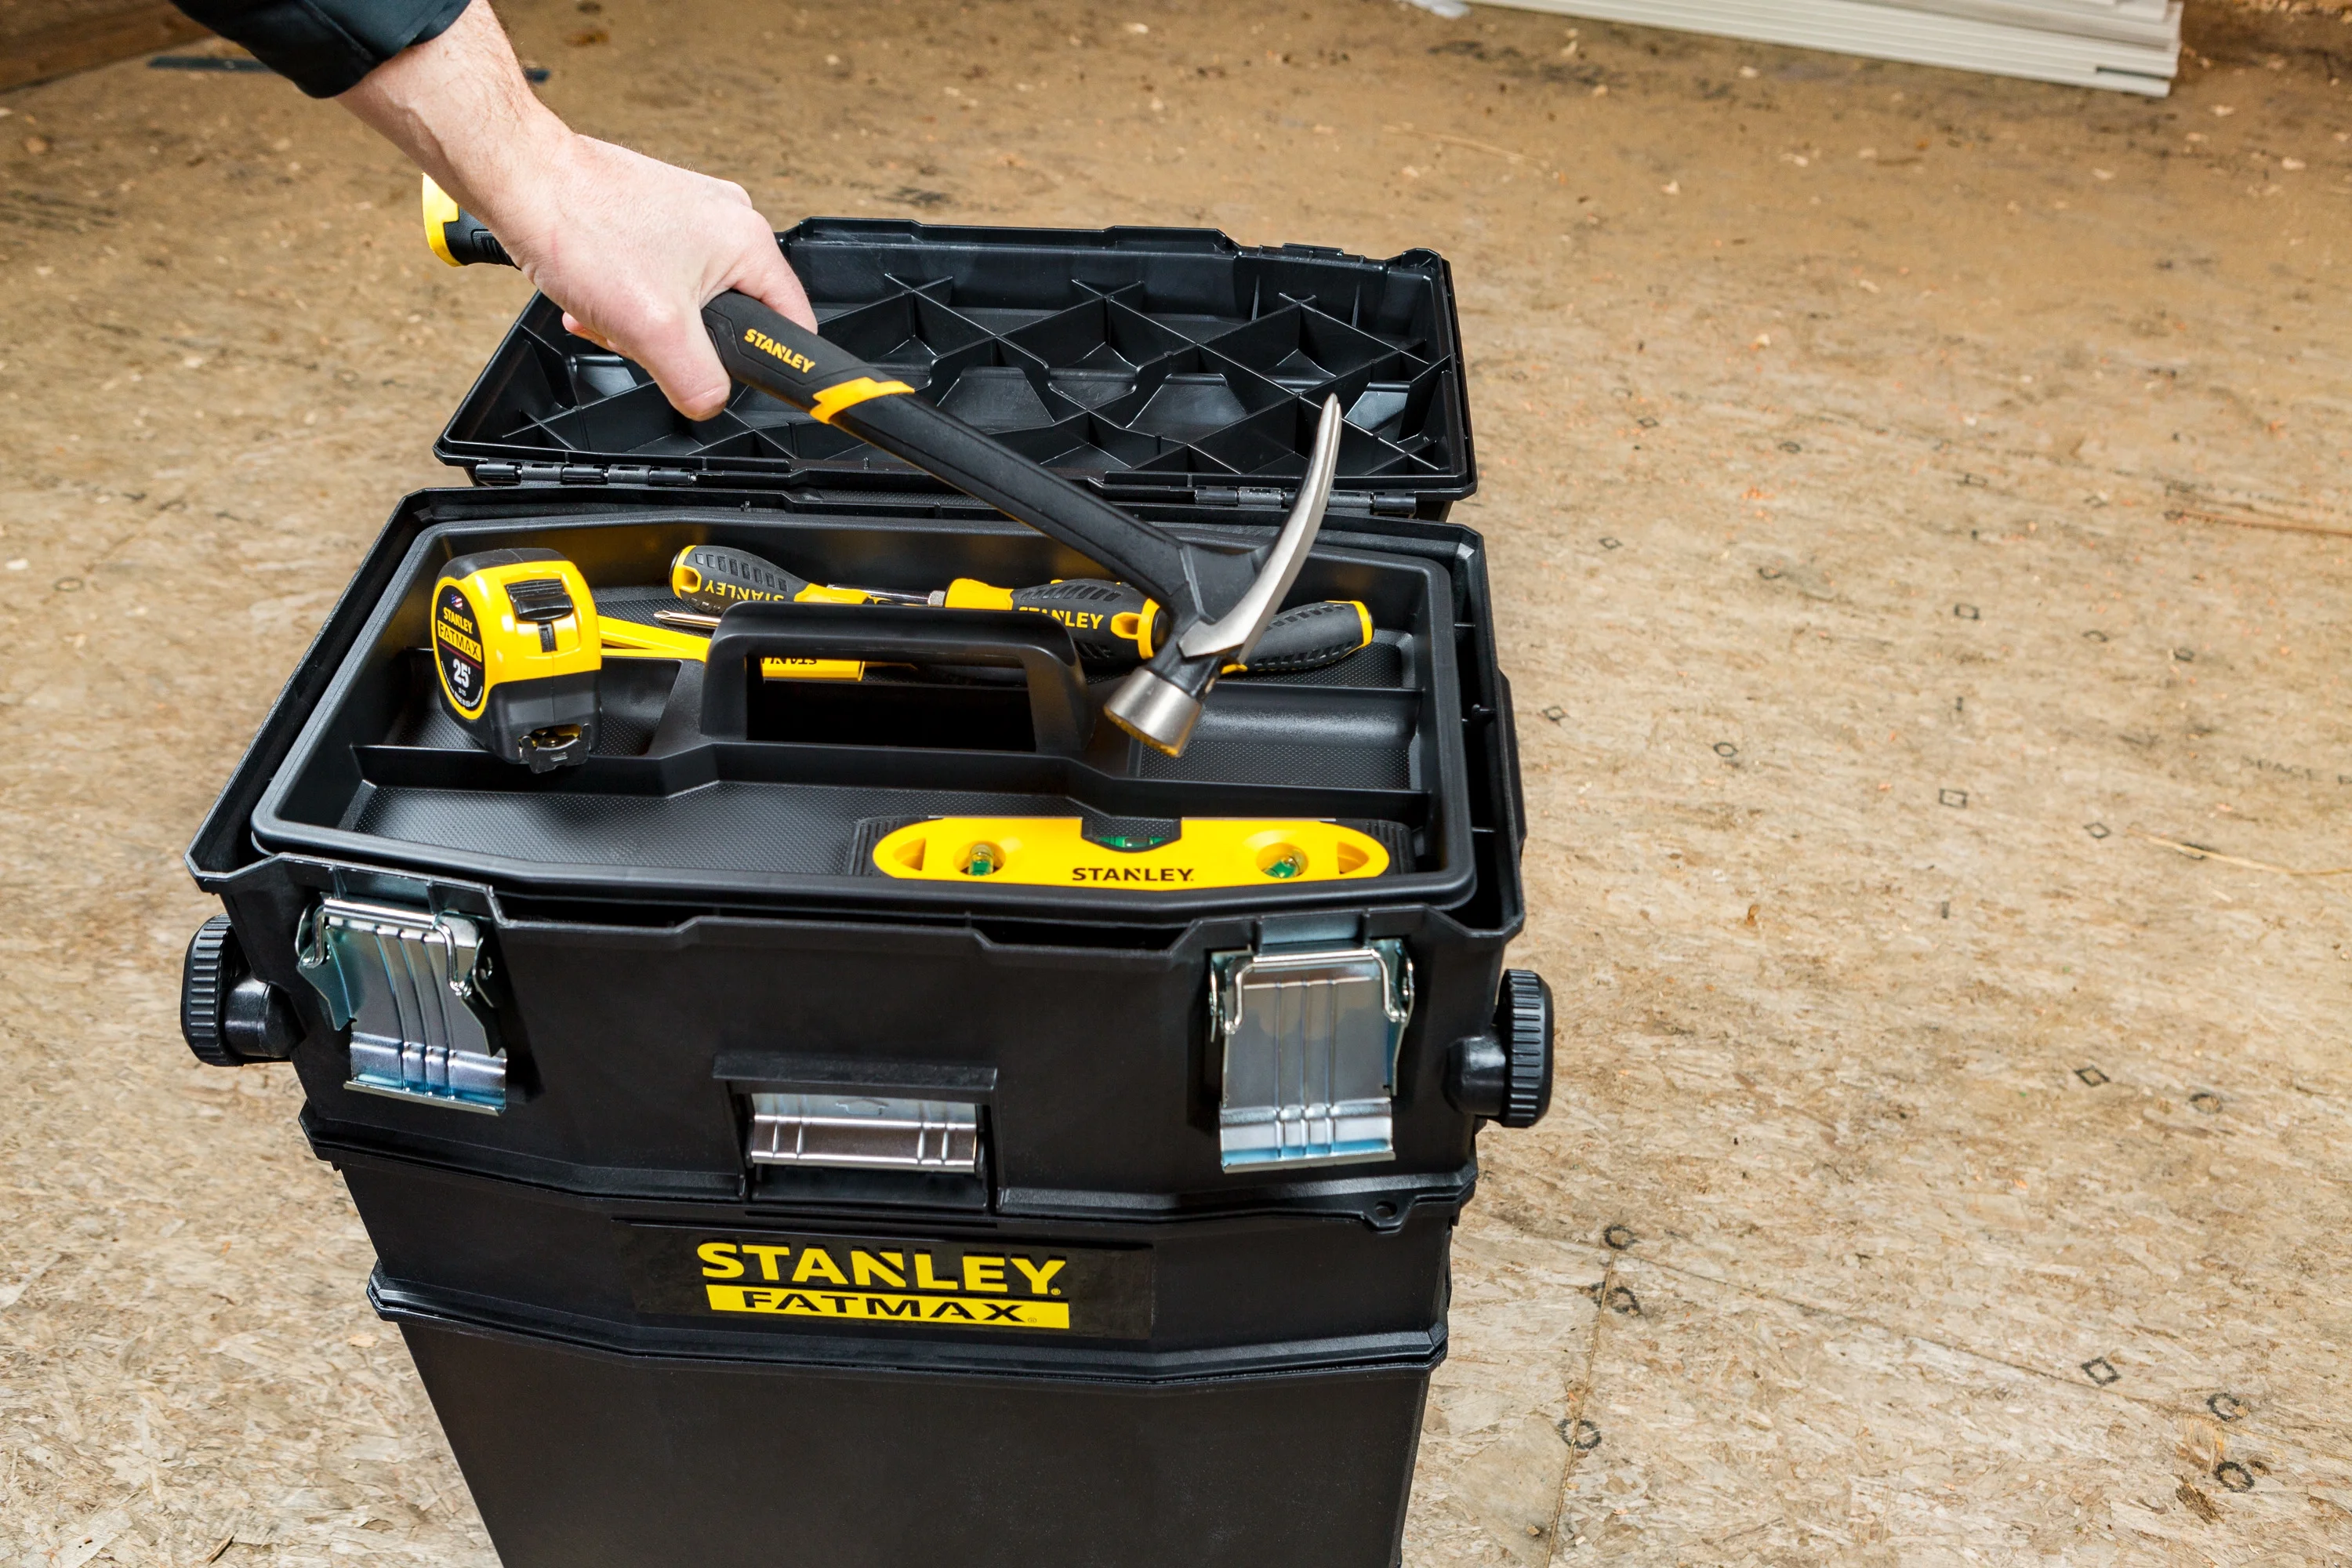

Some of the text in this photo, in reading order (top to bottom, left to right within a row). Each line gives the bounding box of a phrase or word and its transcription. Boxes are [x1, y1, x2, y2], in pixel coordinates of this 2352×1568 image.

[744, 328, 816, 374] STANLEY
[443, 607, 474, 634] STANLEY
[1018, 606, 1104, 630] NLEY
[440, 623, 480, 659] FATMAX
[1072, 867, 1195, 882] STANLEY
